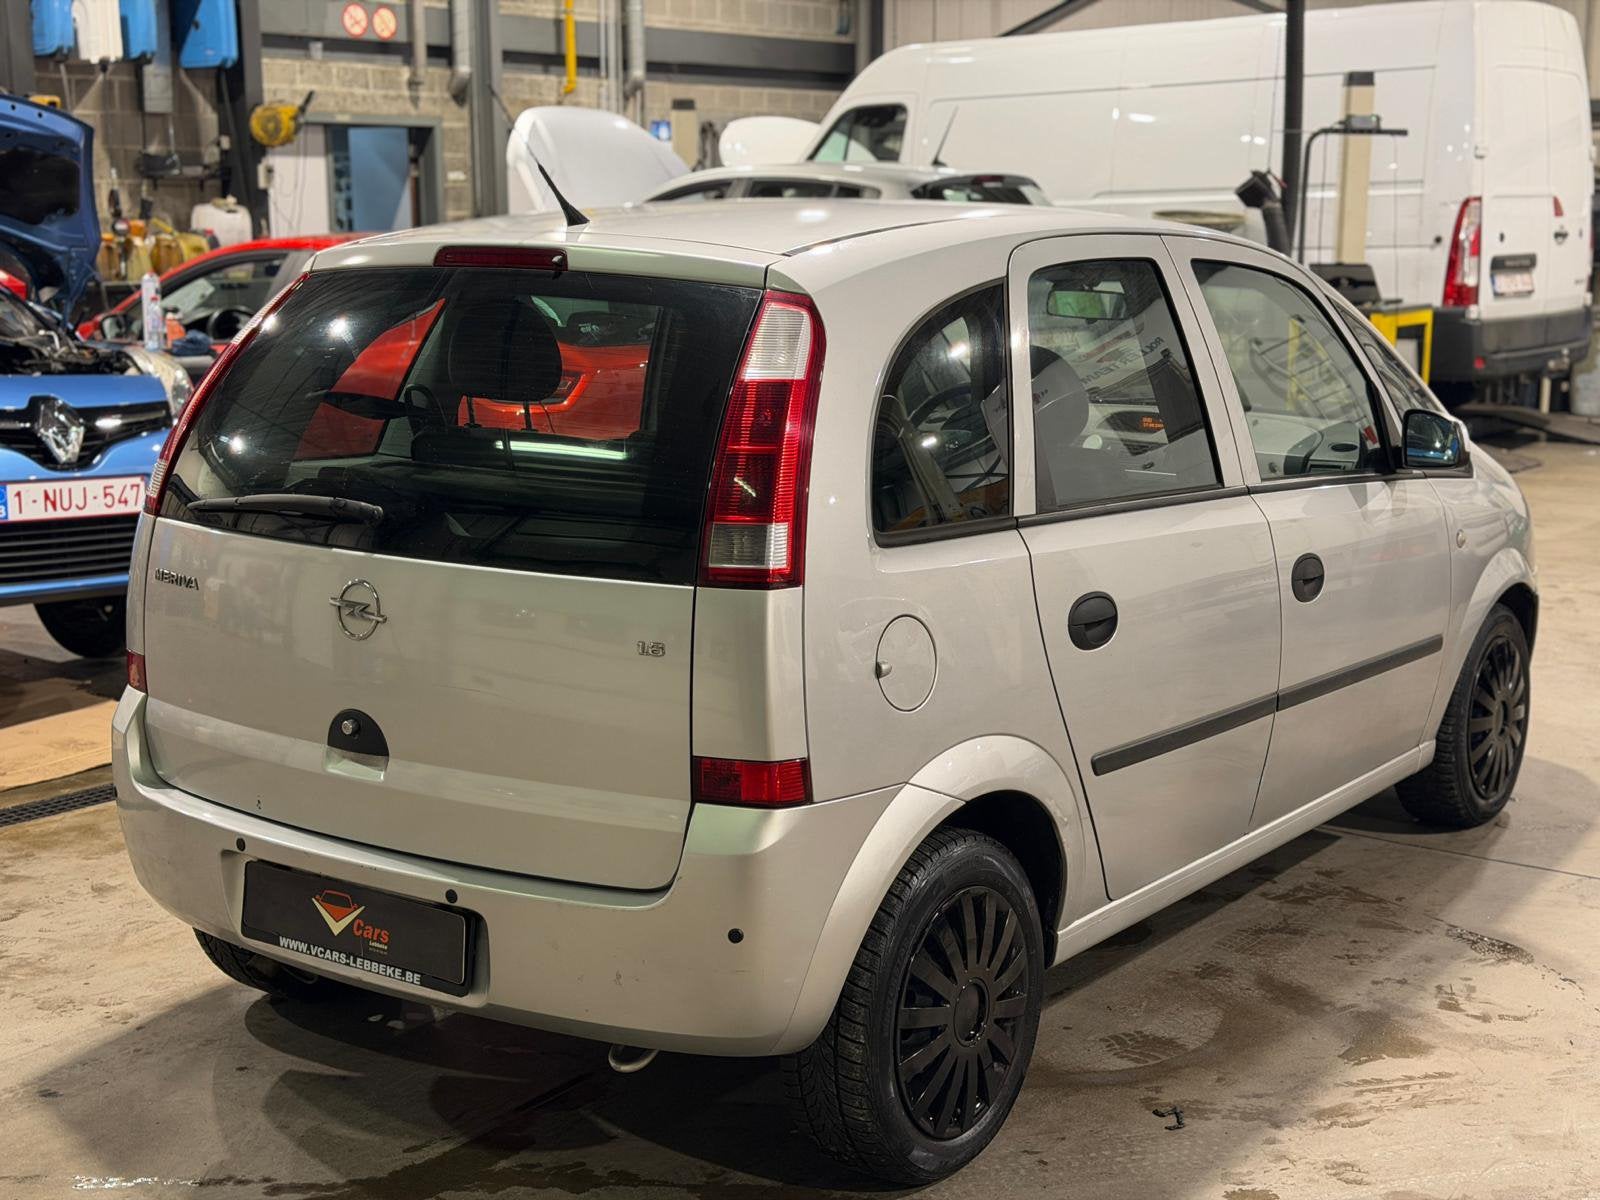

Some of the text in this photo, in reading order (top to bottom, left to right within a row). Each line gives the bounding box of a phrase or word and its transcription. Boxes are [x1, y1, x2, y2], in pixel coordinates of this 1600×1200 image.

[14, 484, 141, 514] 1-NUJ-547
[155, 568, 200, 590] MERIVA
[352, 919, 390, 944] Cars
[278, 936, 422, 985] WWW.VCARS-LEBBEKE.BE
